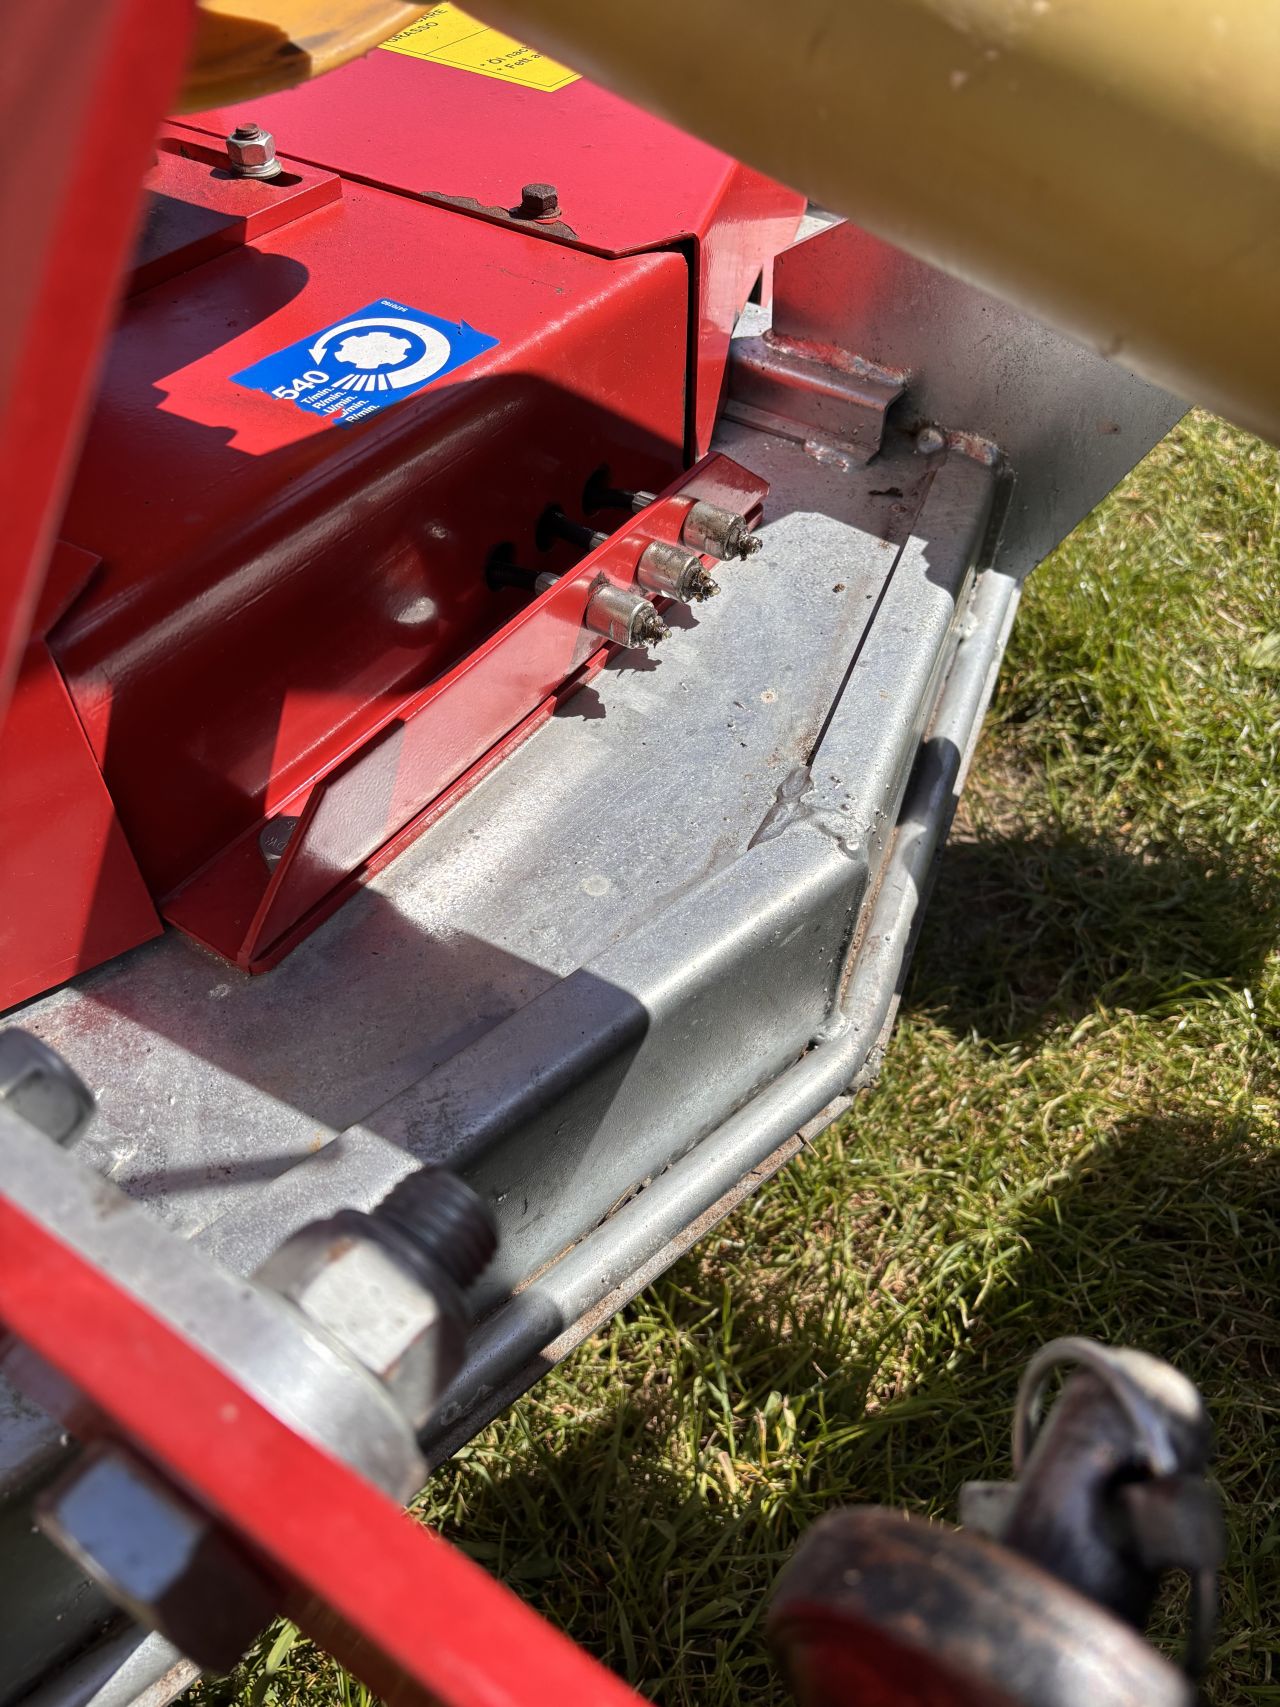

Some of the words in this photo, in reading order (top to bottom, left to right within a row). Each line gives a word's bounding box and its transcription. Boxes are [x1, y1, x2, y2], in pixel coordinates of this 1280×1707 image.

[386, 22, 438, 42] GRASSO
[271, 370, 330, 400] 540
[300, 387, 335, 404] T/min.
[311, 391, 347, 409] R/min.
